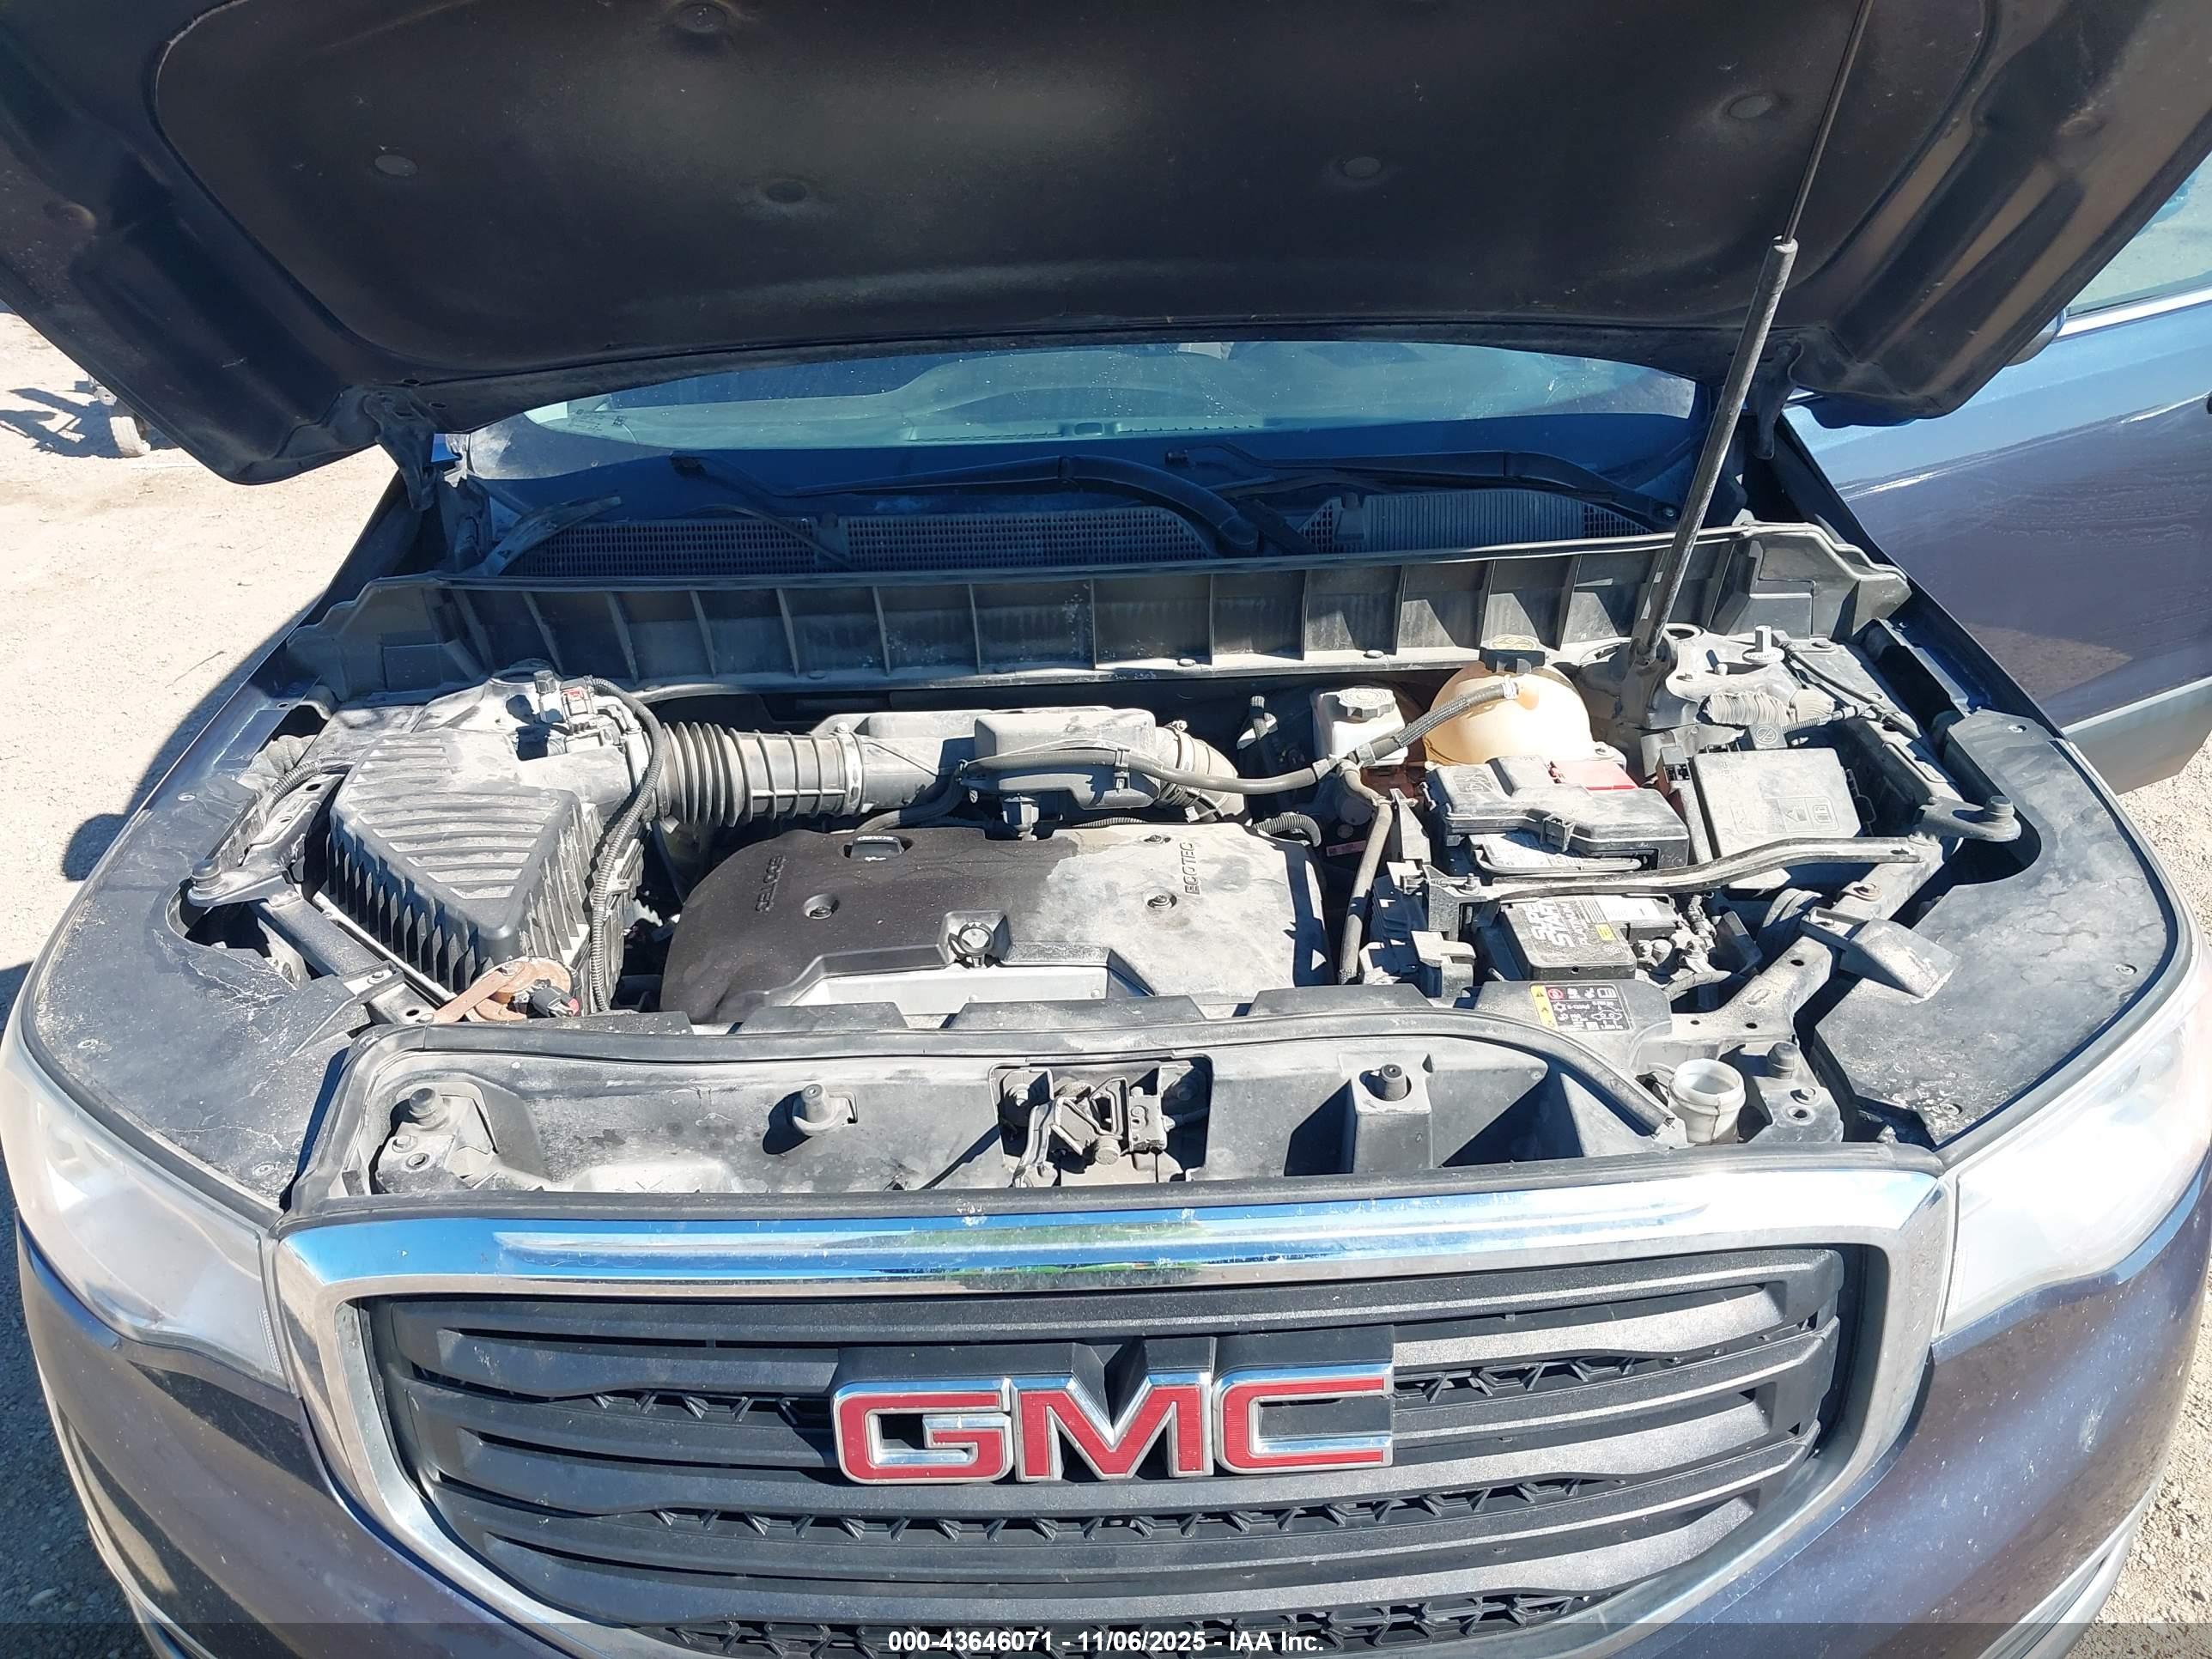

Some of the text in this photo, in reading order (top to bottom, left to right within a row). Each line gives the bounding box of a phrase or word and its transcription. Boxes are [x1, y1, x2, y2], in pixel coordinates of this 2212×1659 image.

[1179, 842, 1201, 896] ECOTEC
[1525, 902, 1547, 941] SUPE
[1560, 902, 1592, 946] PLATINUM
[833, 1364, 1394, 1485] GMC
